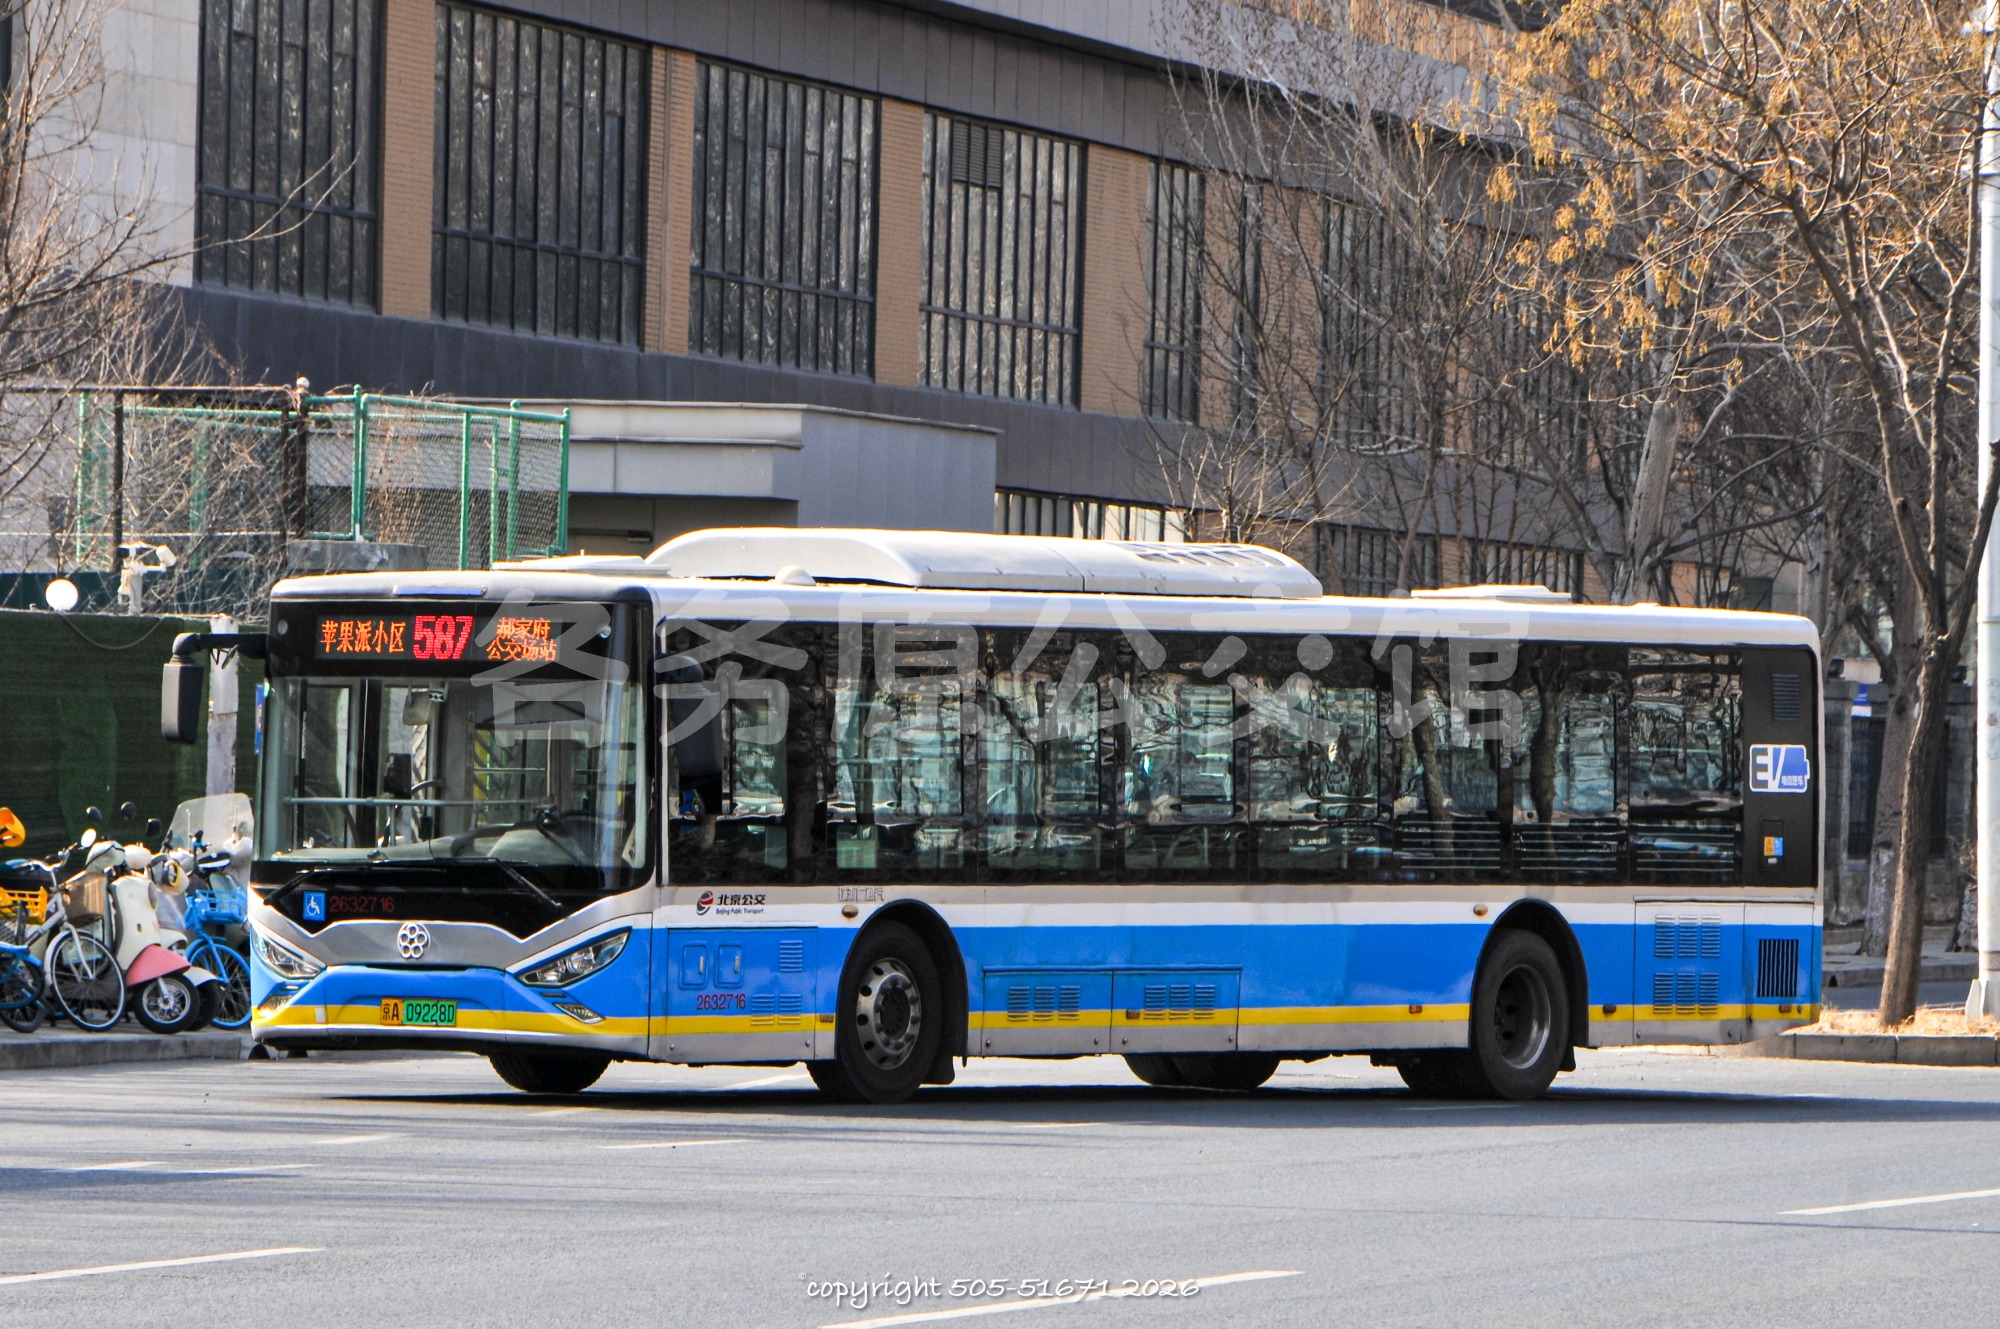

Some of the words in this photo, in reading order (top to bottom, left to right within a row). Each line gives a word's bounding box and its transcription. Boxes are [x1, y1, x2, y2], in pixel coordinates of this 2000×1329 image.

[496, 616, 551, 640] 郝家府
[320, 619, 406, 654] 苹果派小区
[413, 615, 474, 660] 587
[486, 637, 558, 662] 公交场站
[328, 895, 395, 913] 2632716
[717, 893, 766, 906] 北京公交
[716, 907, 731, 916] Beijing
[731, 907, 743, 915] Public
[744, 907, 764, 915] Transport
[696, 993, 747, 1010] 2632716
